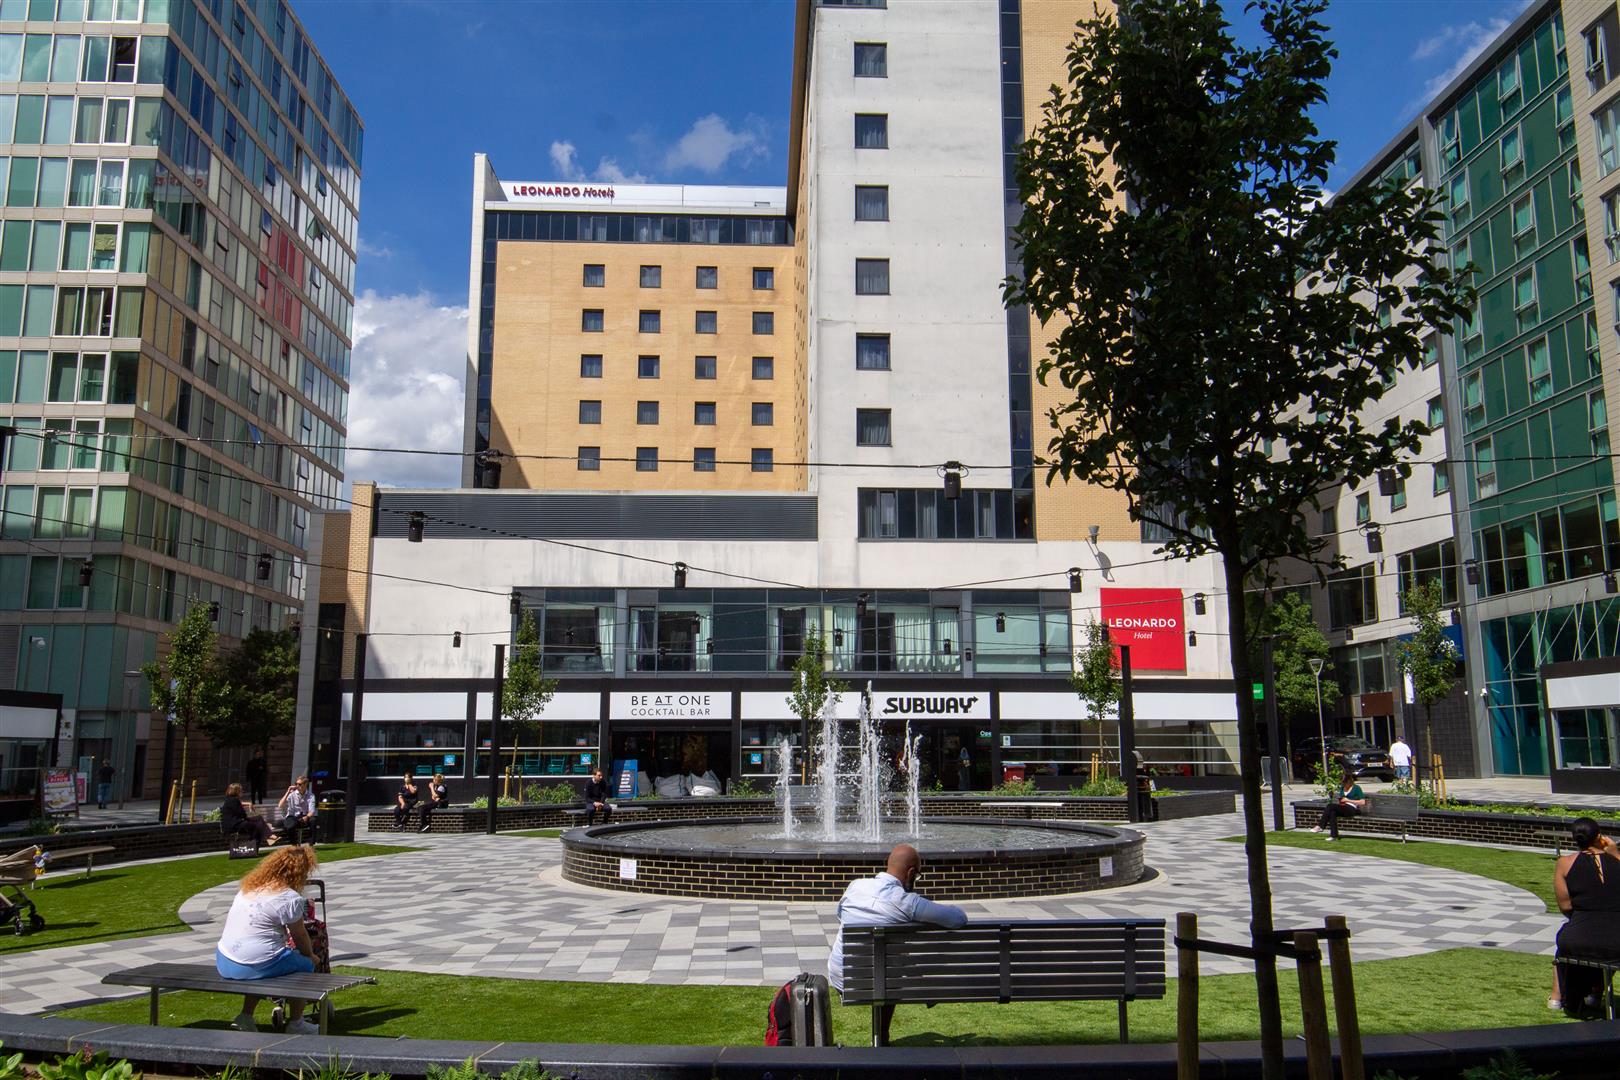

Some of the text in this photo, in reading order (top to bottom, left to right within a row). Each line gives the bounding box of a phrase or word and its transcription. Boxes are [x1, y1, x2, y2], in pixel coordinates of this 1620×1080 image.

[513, 185, 615, 199] LEONARDO Hotels
[1108, 618, 1177, 628] LEONARDO
[1133, 631, 1153, 639] Hotel
[631, 695, 711, 706] BE AT ONE
[882, 696, 979, 715] SUBWAY
[631, 708, 711, 716] COCKTAIL BAR
